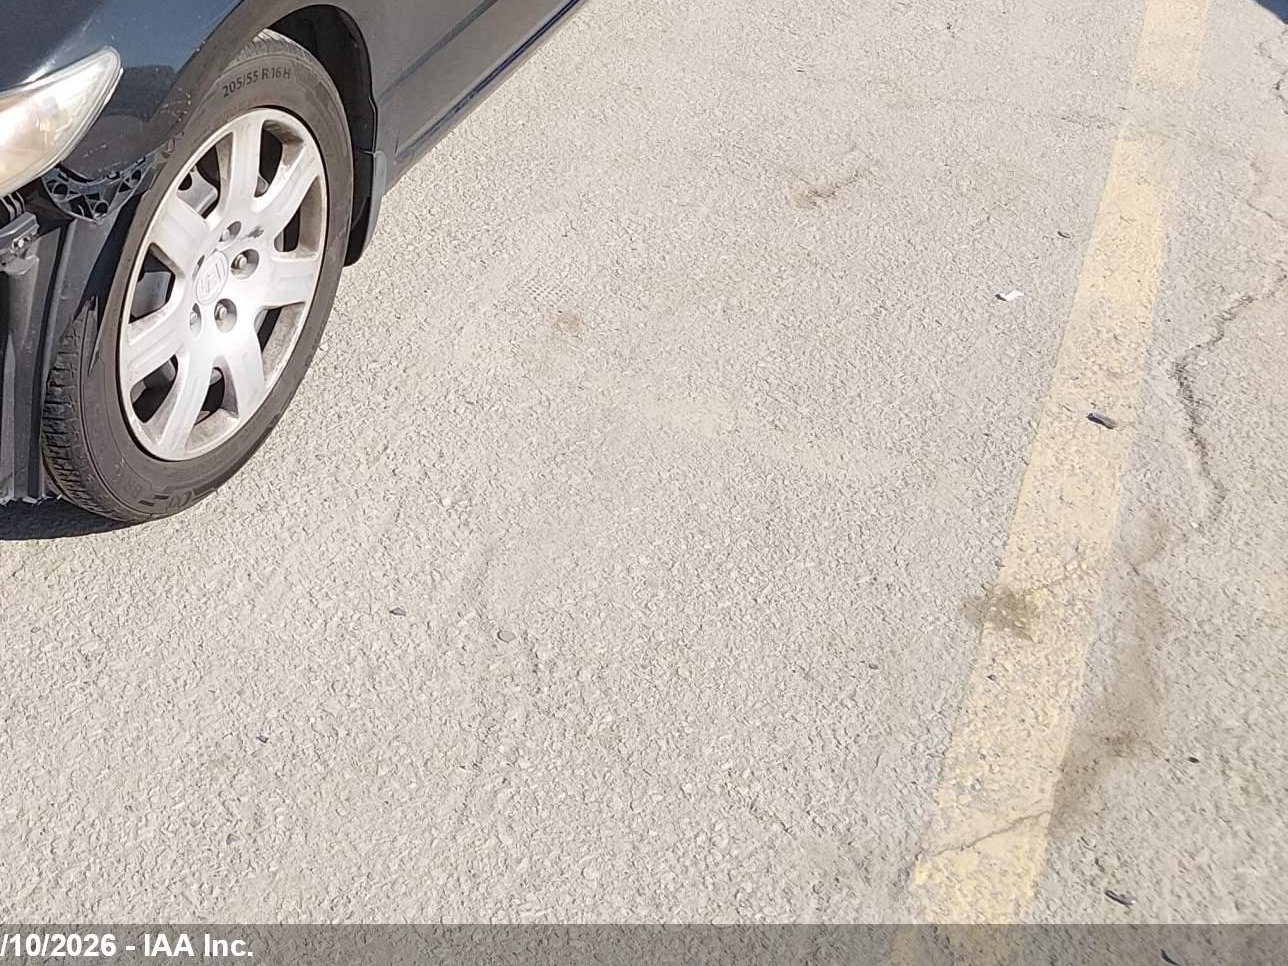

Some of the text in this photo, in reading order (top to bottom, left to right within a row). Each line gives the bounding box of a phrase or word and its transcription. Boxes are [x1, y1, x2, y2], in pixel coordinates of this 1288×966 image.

[222, 66, 292, 98] 205/55 R 16 H
